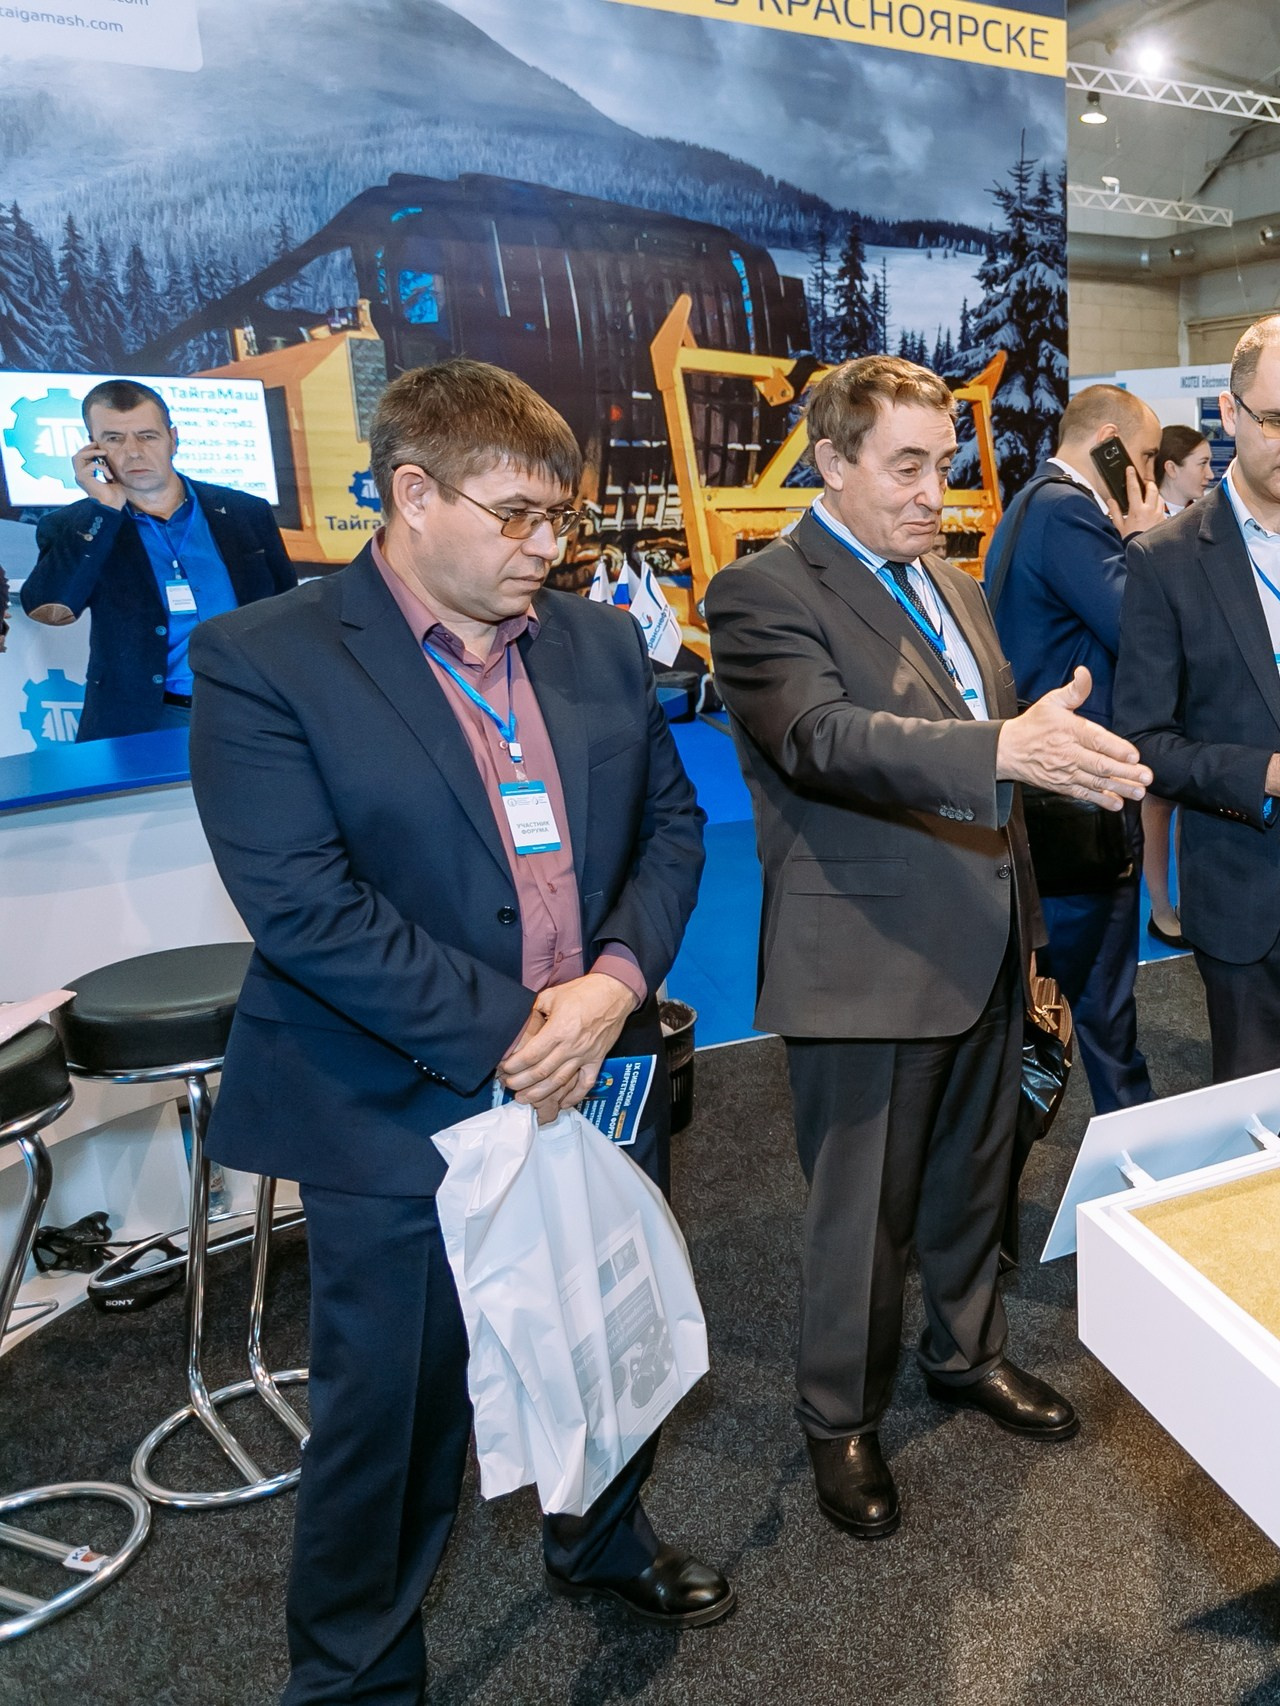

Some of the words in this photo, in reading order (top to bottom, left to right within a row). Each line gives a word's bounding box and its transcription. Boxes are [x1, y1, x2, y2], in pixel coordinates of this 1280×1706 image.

[168, 386, 259, 400] ТайгаМаш
[648, 604, 668, 648] ранснефт
[516, 821, 550, 829] УЧАСТНИК
[521, 827, 549, 835] ФОРУМА
[612, 1063, 633, 1117] ЭНЕРГЕТИЧЕСКИЙ
[624, 1070, 640, 1107] СИБИРСКИЙ
[105, 1298, 135, 1306] SONY
